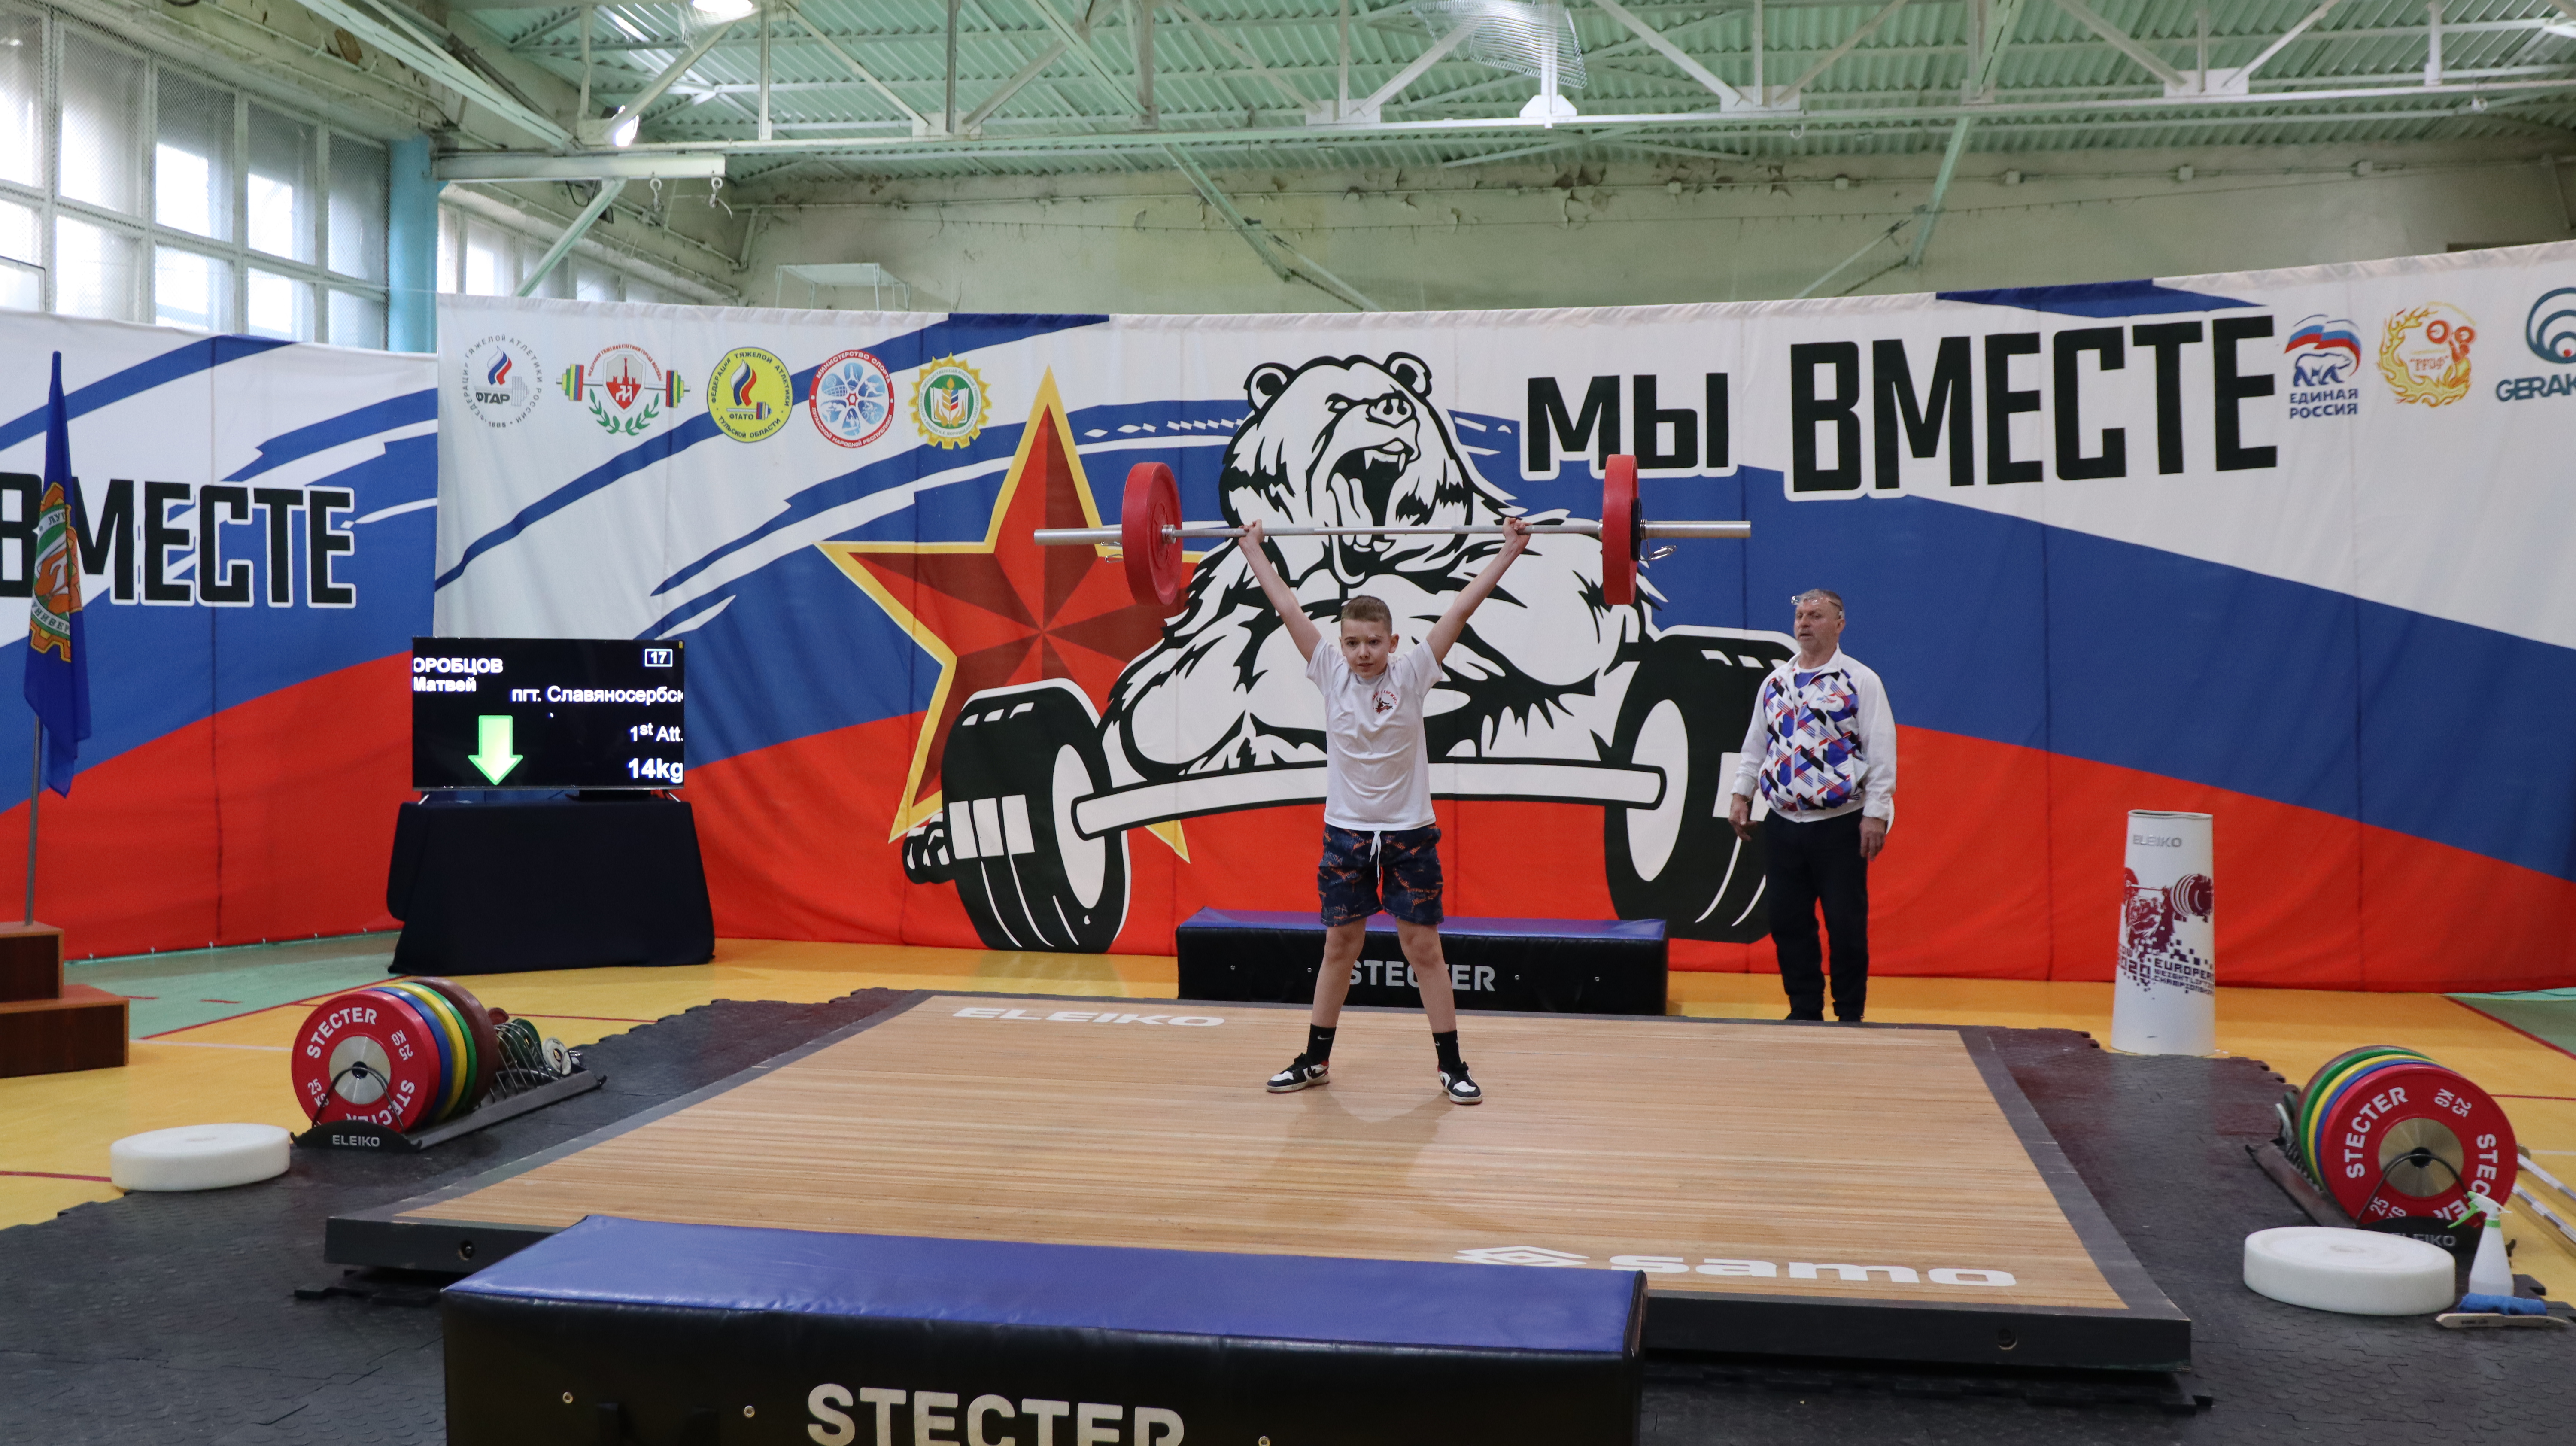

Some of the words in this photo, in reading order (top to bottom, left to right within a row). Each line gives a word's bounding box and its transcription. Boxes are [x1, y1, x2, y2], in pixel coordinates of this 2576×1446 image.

[510, 337, 543, 383] АТЛЕТИКИ
[816, 351, 870, 379] МИНИСТЕРСТВО
[872, 358, 891, 384] СПОРТА
[711, 358, 731, 403] ФЕДЕРАЦИЯ
[734, 352, 772, 364] ТЯЖЕЛОЙ
[775, 365, 790, 407] АТЛЕТИКИ
[516, 388, 541, 424] РОССИИ
[1527, 373, 1728, 472] МЫ
[1790, 315, 2278, 493] ВМЕСТЕ
[2290, 388, 2359, 404] ЕДИНАЯ
[2290, 403, 2358, 419] РОССИЯ
[718, 416, 746, 438] ТУЛЬСКОЙ
[750, 418, 781, 438] ОБЛАСТИ
[811, 407, 832, 439] ЛУГАНСКОЙ
[832, 437, 862, 448] НАРОДНОЙ
[863, 415, 892, 444] РЕСПУБЛИКИ
[651, 651, 667, 663] 17
[414, 676, 476, 692] Матвей
[512, 689, 541, 702] пгт.
[630, 722, 653, 741] 1st
[656, 726, 683, 741] Att.
[629, 758, 683, 783] 14kg
[2133, 835, 2182, 847] ELEIKO
[1350, 960, 1496, 991] STECER
[953, 1007, 1225, 1027] ELEIKO
[307, 1007, 377, 1058] STECTER
[391, 1030, 407, 1046] KG
[398, 1044, 413, 1061] 25
[307, 1078, 322, 1095] 25
[2434, 1088, 2455, 1107] KG
[2451, 1097, 2472, 1117] 25
[332, 1135, 380, 1147] ELEIKO
[2344, 1087, 2409, 1178] STECTER
[2370, 1197, 2389, 1216] 25
[1610, 1255, 2017, 1287] samo
